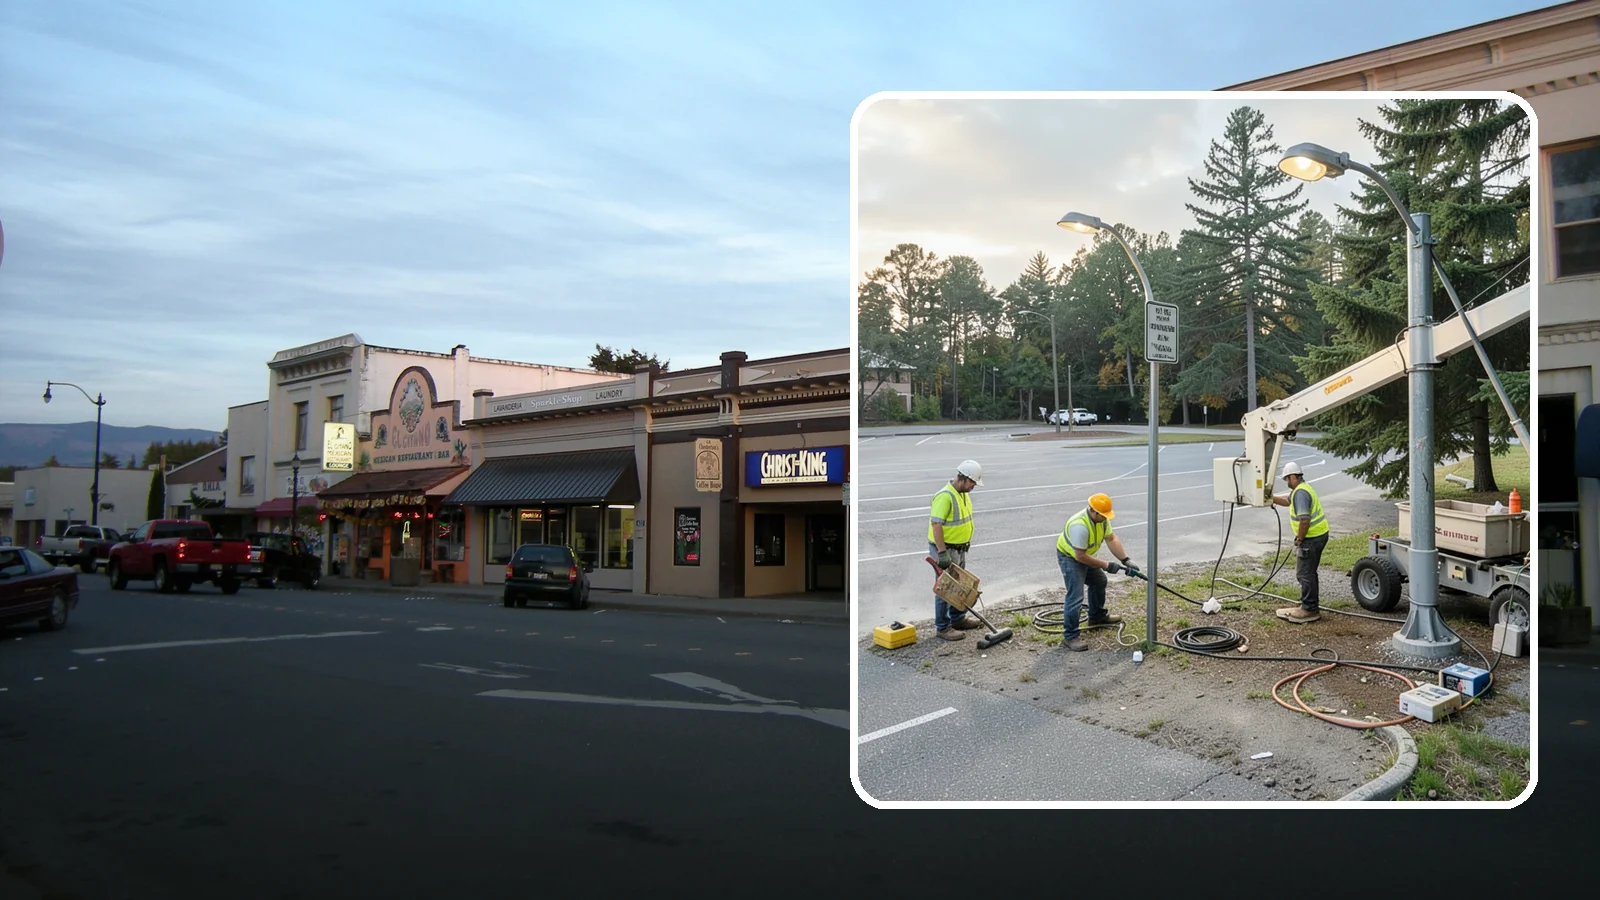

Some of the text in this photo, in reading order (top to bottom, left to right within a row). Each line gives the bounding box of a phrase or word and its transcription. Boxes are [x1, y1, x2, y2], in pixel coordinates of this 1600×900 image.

[562, 394, 583, 407] Shop
[595, 389, 624, 400] LAUNDRY
[493, 402, 523, 413] LAVANDERIA
[373, 454, 396, 464] MEXICAN
[397, 451, 433, 463] RESTAURANT
[438, 450, 450, 459] BAR
[760, 450, 827, 478] CHRIST KING
